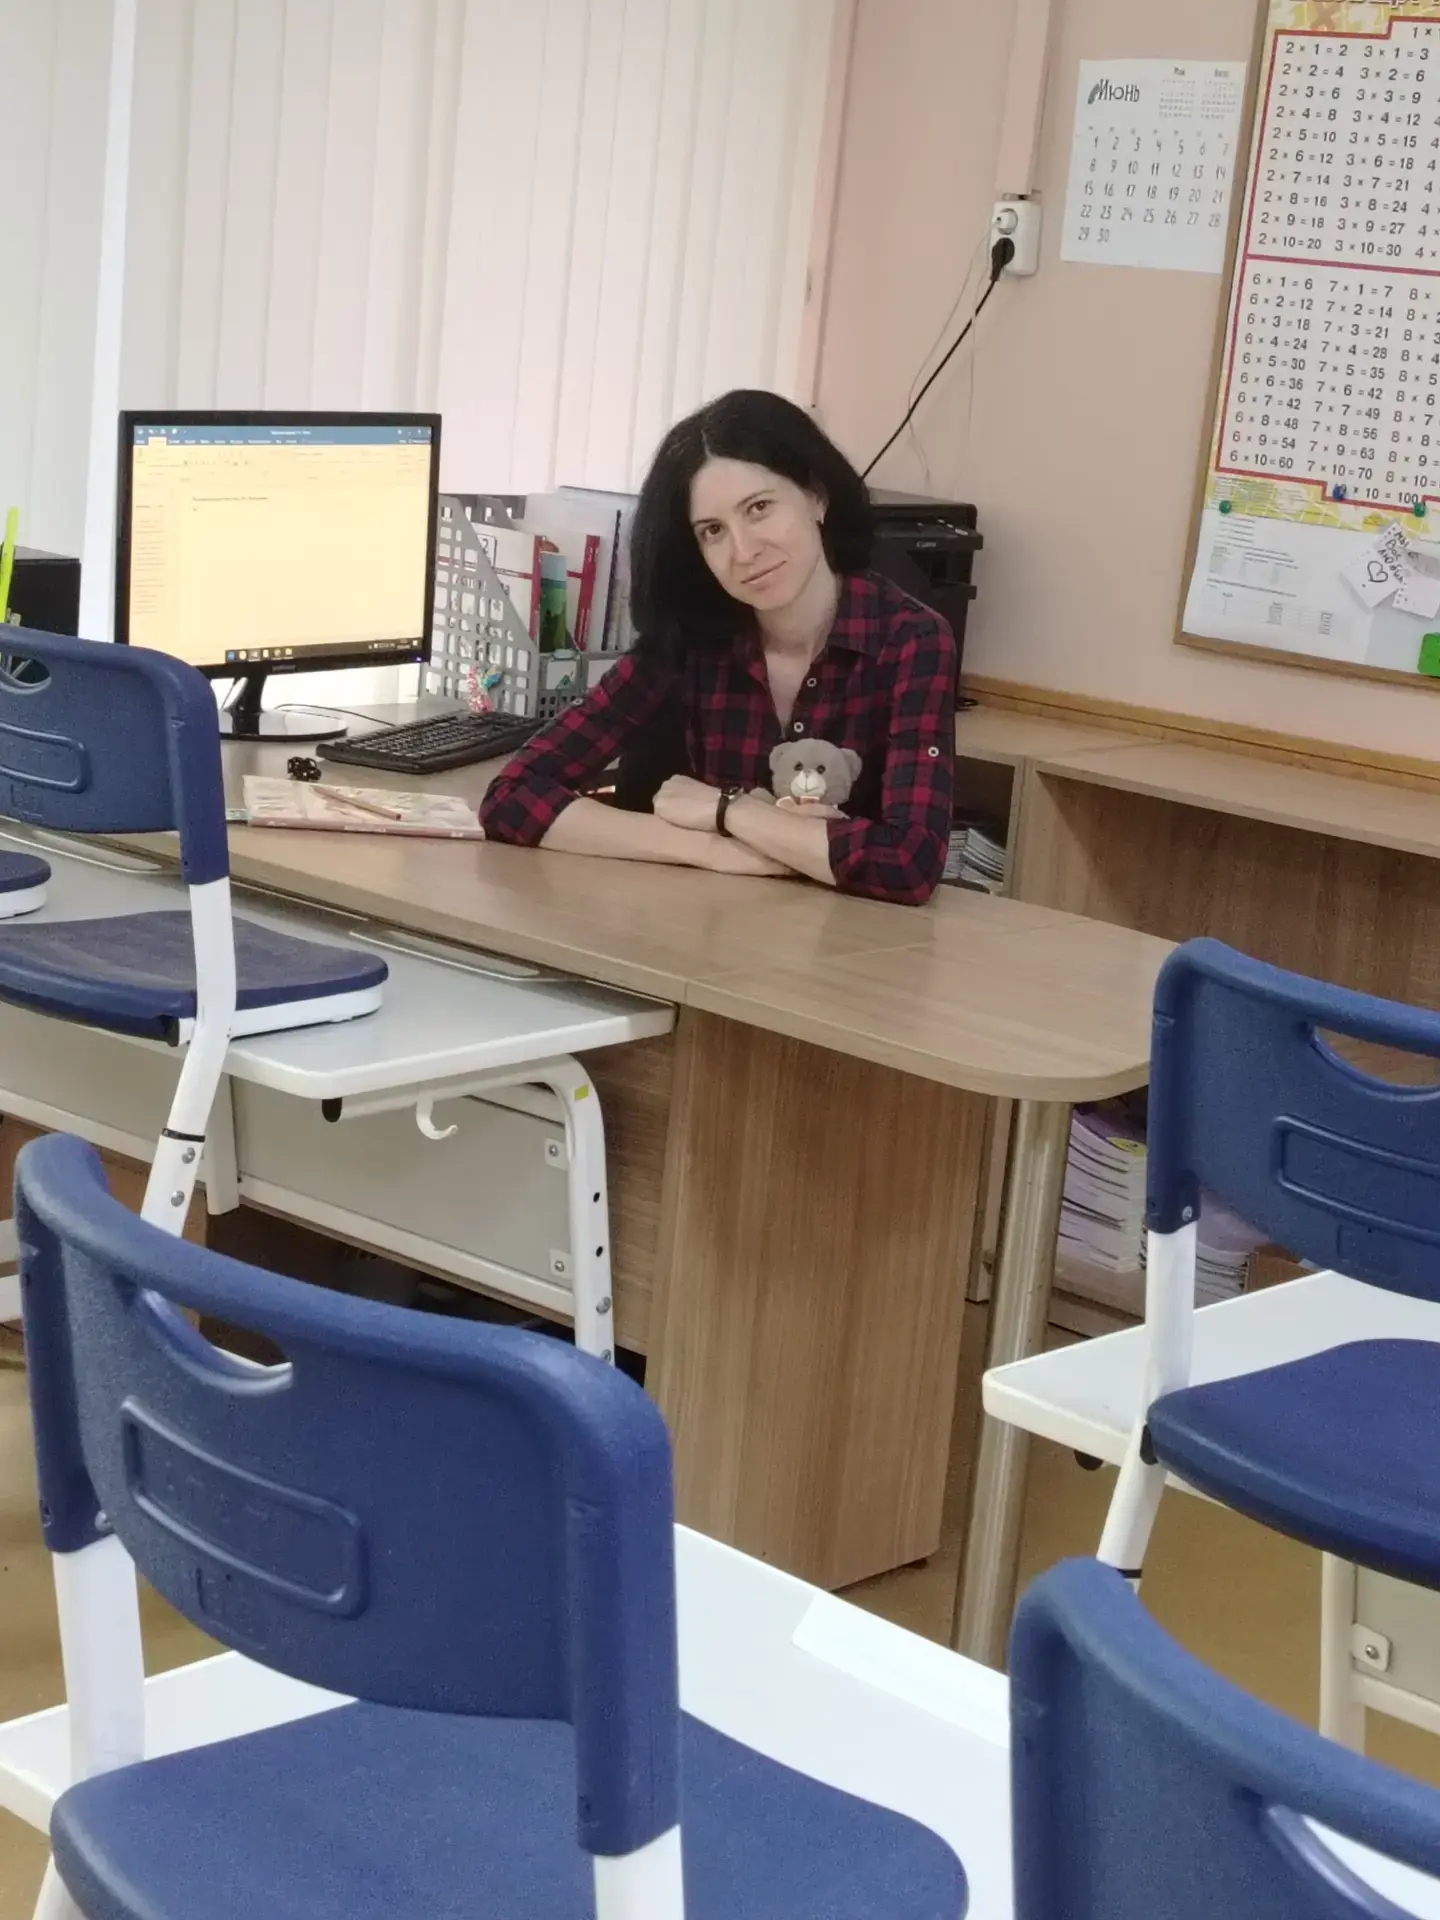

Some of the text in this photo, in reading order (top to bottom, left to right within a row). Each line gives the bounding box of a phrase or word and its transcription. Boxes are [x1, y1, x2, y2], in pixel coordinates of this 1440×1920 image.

[1286, 42, 1348, 56] 2 1 2
[1364, 45, 1429, 60] 3 1 3
[1283, 63, 1343, 77] 2 2 4
[1360, 67, 1425, 82] 3 2 6
[1279, 85, 1340, 99] 2 3 6
[1356, 89, 1421, 104] 3 3 9
[1276, 106, 1337, 121] 2 4 8
[1353, 110, 1420, 126] 3 4 12
[1273, 127, 1336, 143] 2 5 10
[1349, 132, 1416, 148] 3 5 15
[1094, 136, 1099, 148] 1
[1112, 136, 1119, 150] 2
[1156, 140, 1162, 152] 4
[1178, 139, 1184, 155] 5
[1270, 148, 1333, 164] 2 6 12
[1346, 153, 1414, 170] 3 6 18
[1089, 158, 1097, 172] 8
[1111, 159, 1117, 173] 9
[1128, 160, 1139, 175] 10
[1151, 162, 1160, 176] 11
[1172, 163, 1181, 177] 12
[1267, 170, 1330, 185] 2 7 14
[1344, 175, 1409, 191] 3 7 21
[1084, 180, 1180, 201] 15 16 17 18 19
[1264, 191, 1327, 207] 2 8 16
[1340, 197, 1407, 213] 3 8 24
[1080, 204, 1092, 218] 22
[1100, 205, 1112, 220] 23
[1164, 209, 1176, 224] 26
[1187, 211, 1199, 225] 27
[1261, 212, 1324, 228] 2 9 18
[1338, 218, 1405, 234] 3 9 27
[1259, 233, 1321, 249] 2 10 20
[1335, 240, 1401, 256] 3 10 30
[1253, 273, 1312, 290] 6 1 6
[1330, 281, 1393, 297] 7 1 7
[1250, 293, 1313, 310] 6 2 12
[1327, 301, 1392, 318] 7 2 14
[1247, 313, 1310, 330] 6 3 18
[1324, 321, 1388, 339] 7 3 21
[1245, 333, 1307, 350] 6 4 24
[1322, 341, 1387, 359] 7 4 28
[1243, 352, 1305, 370] 6 5 30
[1319, 361, 1385, 379] 7 5 35
[1241, 372, 1303, 390] 6 6 36
[1317, 381, 1383, 400] 7 6 42
[1238, 392, 1301, 410] 6 7 42
[1315, 401, 1380, 420] 7 7 49
[1236, 411, 1298, 430] 6 8 48
[1312, 421, 1377, 440] 7 8 56
[1233, 431, 1295, 449] 6 9 54
[1310, 441, 1374, 460] 7 9 63
[1230, 450, 1293, 469] 6 10 60
[1308, 460, 1372, 480] 7 10 70
[1366, 488, 1379, 499] 10
